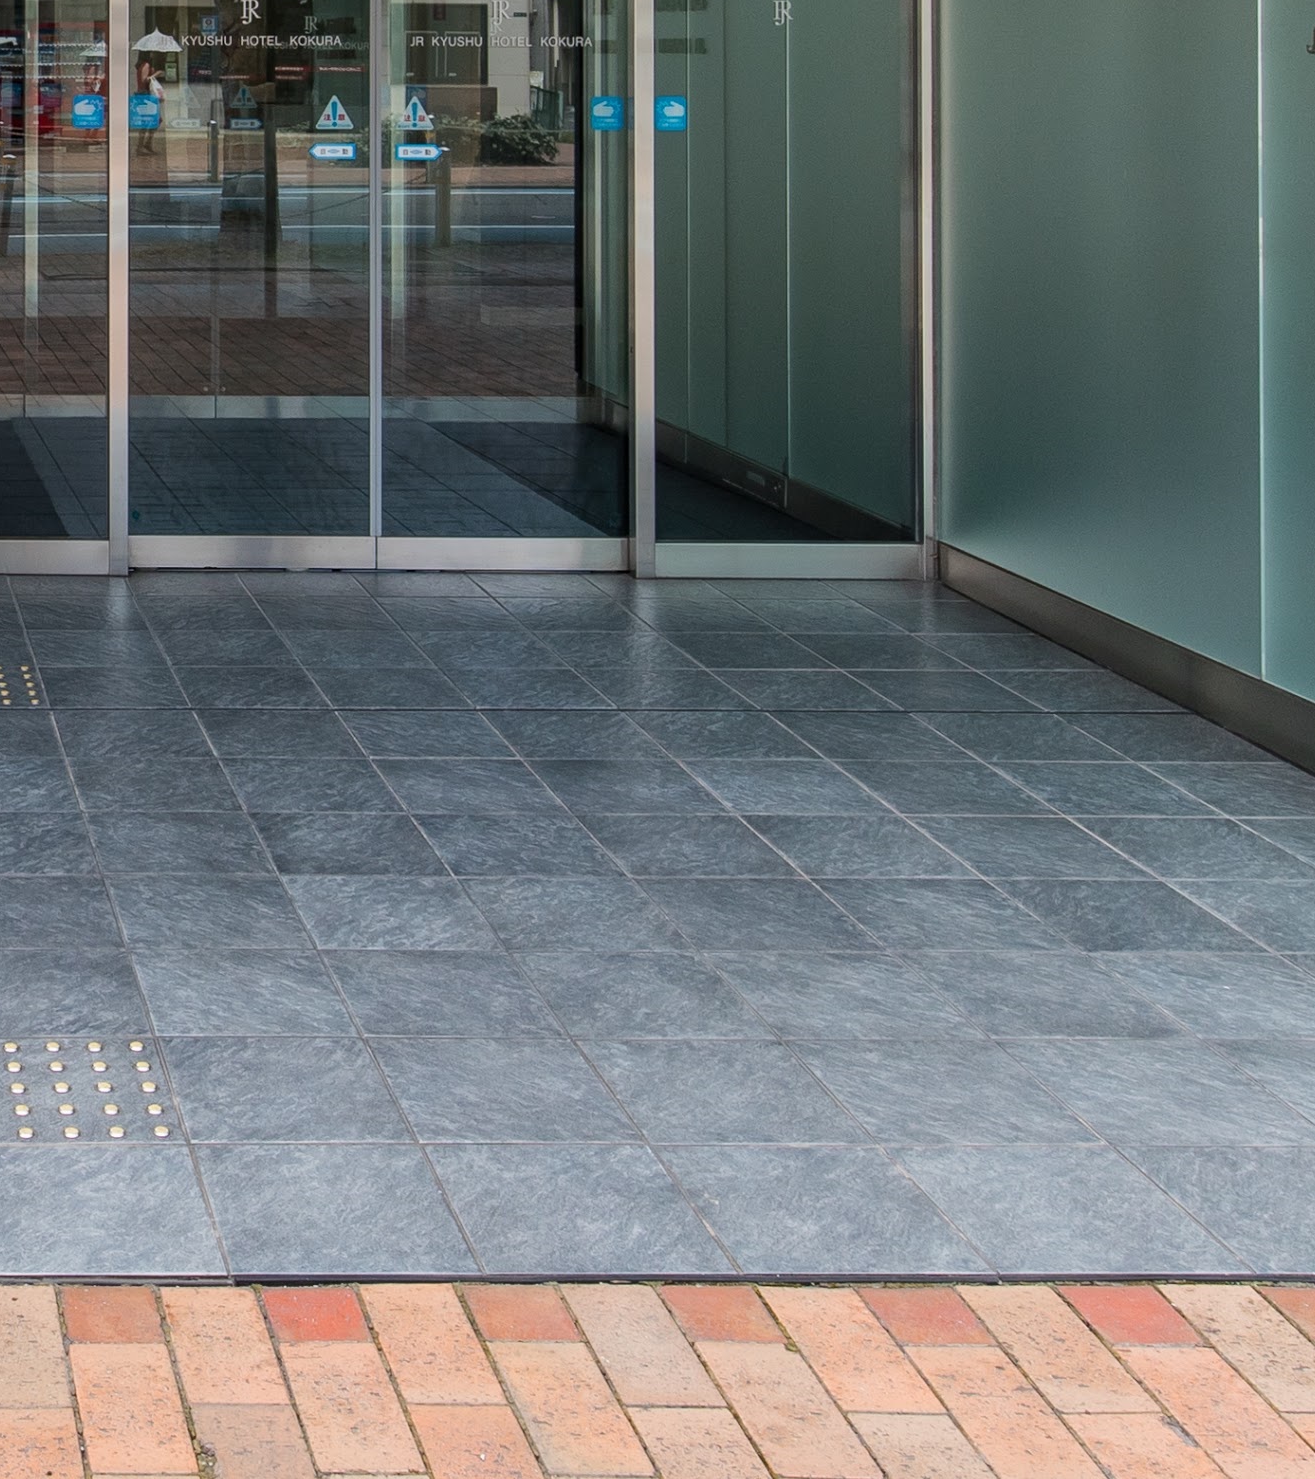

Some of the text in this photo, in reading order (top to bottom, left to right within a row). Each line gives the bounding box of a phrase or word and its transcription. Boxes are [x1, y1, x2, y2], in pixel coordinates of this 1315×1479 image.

[180, 35, 233, 47] KYUSHU
[240, 35, 282, 47] HOTEL
[289, 35, 343, 47] KOKURA
[409, 36, 593, 48] JR KYUSHU HOTEL KOKURA
